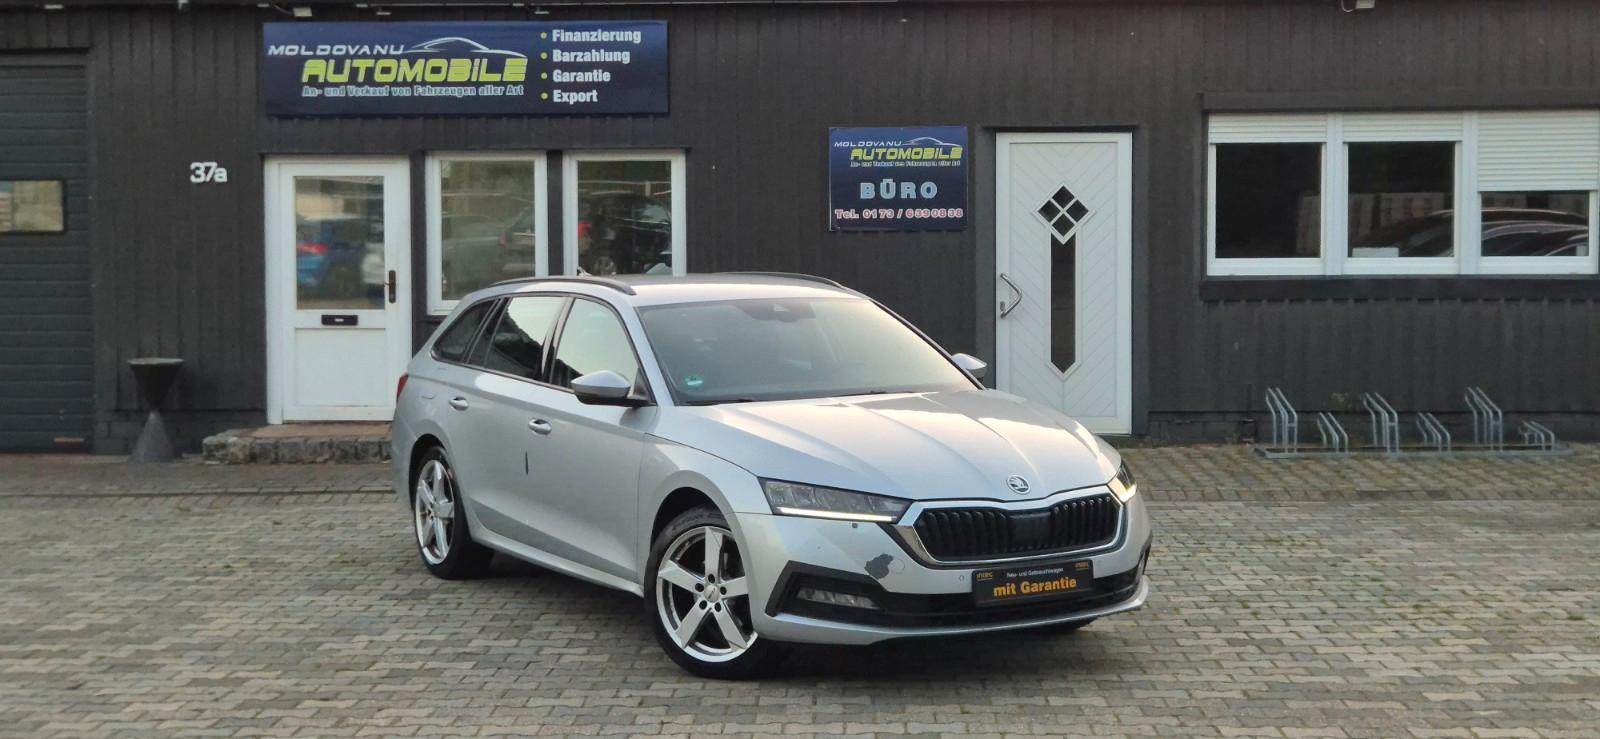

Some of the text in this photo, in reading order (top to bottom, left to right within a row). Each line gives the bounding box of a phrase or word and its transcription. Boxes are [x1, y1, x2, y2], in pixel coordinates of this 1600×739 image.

[552, 29, 642, 44] Finanzierung
[268, 44, 405, 55] MOLDOVANU
[552, 49, 631, 64] Barzahlung
[301, 58, 529, 82] AUTOMOBILE
[552, 69, 611, 82] Garantie
[302, 84, 525, 98] An- und Verkauf von Fahrzeugen aller Art
[553, 89, 599, 105] Export
[850, 147, 963, 160] AUTOMOBILE
[190, 161, 228, 182] 37a
[860, 178, 938, 199] BÜRO
[834, 208, 860, 219] Tel.
[862, 208, 895, 219] 0173
[896, 208, 904, 219] /
[993, 577, 1077, 597] mit Garantie
